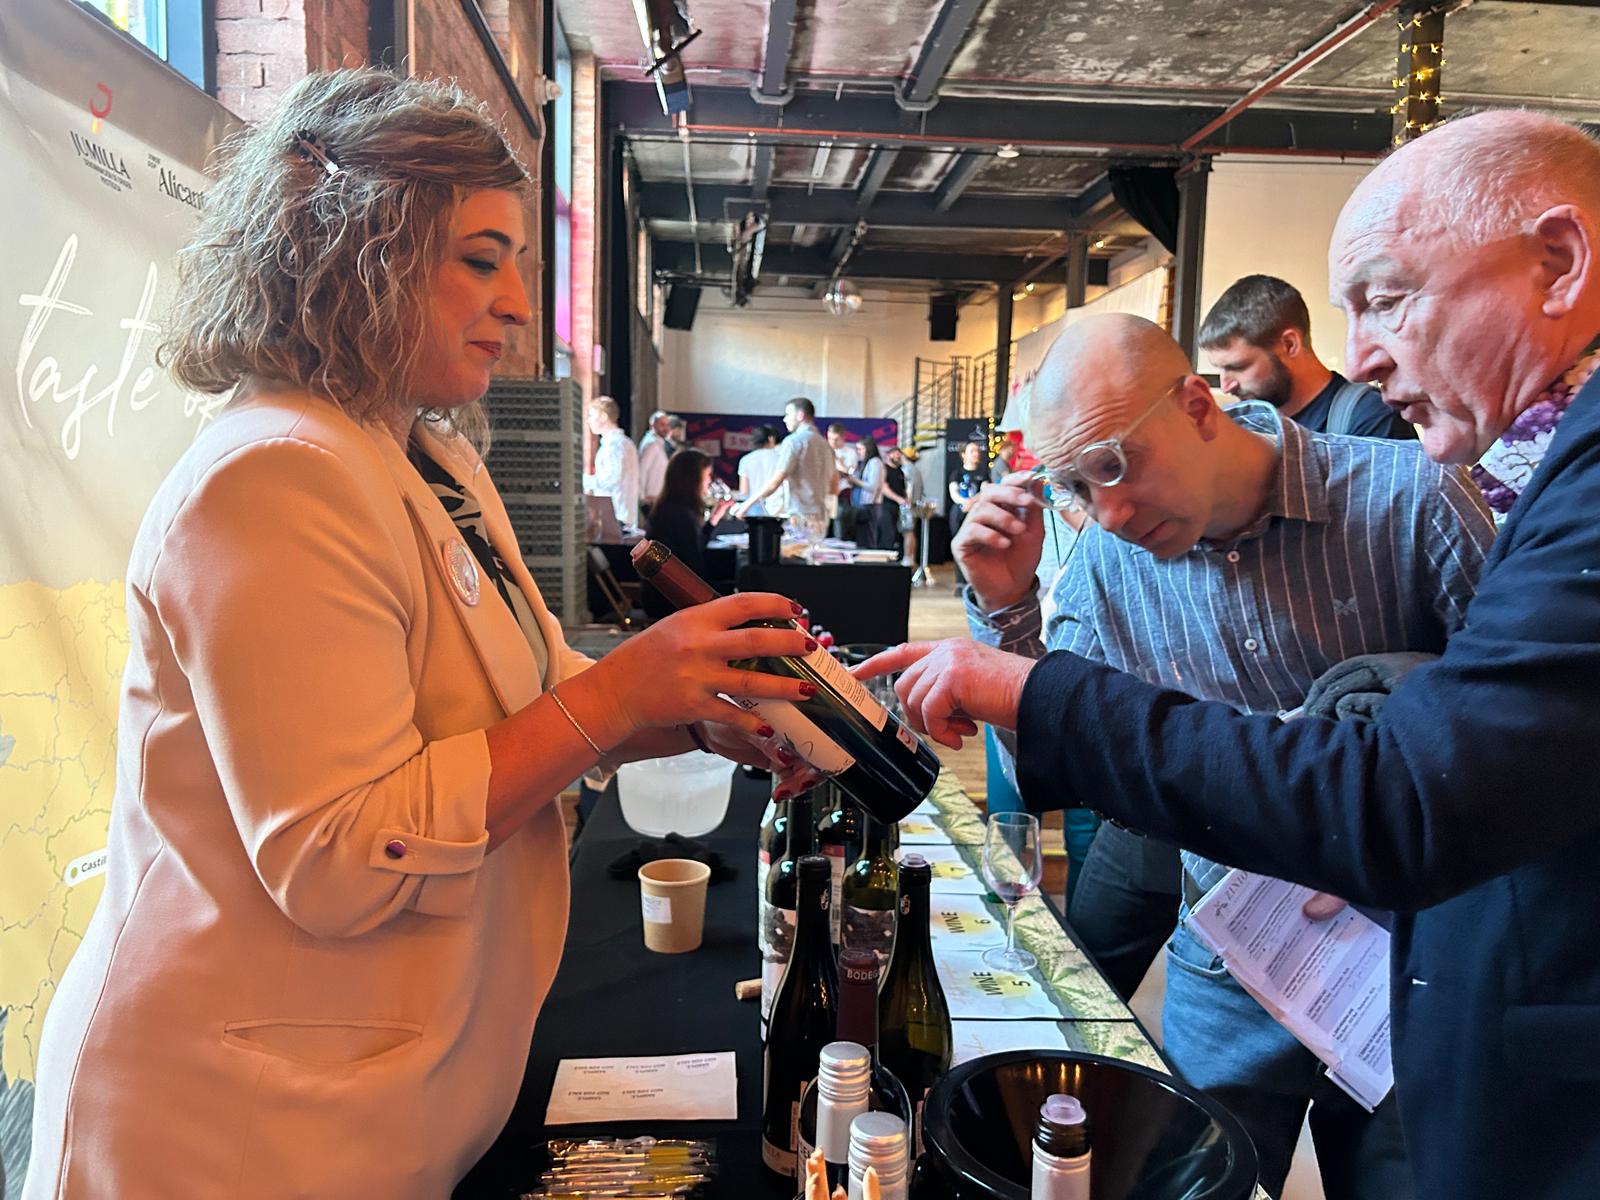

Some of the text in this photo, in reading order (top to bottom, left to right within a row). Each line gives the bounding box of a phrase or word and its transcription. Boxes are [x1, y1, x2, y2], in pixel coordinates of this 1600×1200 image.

[69, 130, 131, 180] JUMILLA
[16, 233, 162, 460] taste
[940, 911, 965, 934] WINE
[972, 971, 1031, 996] WINE 5
